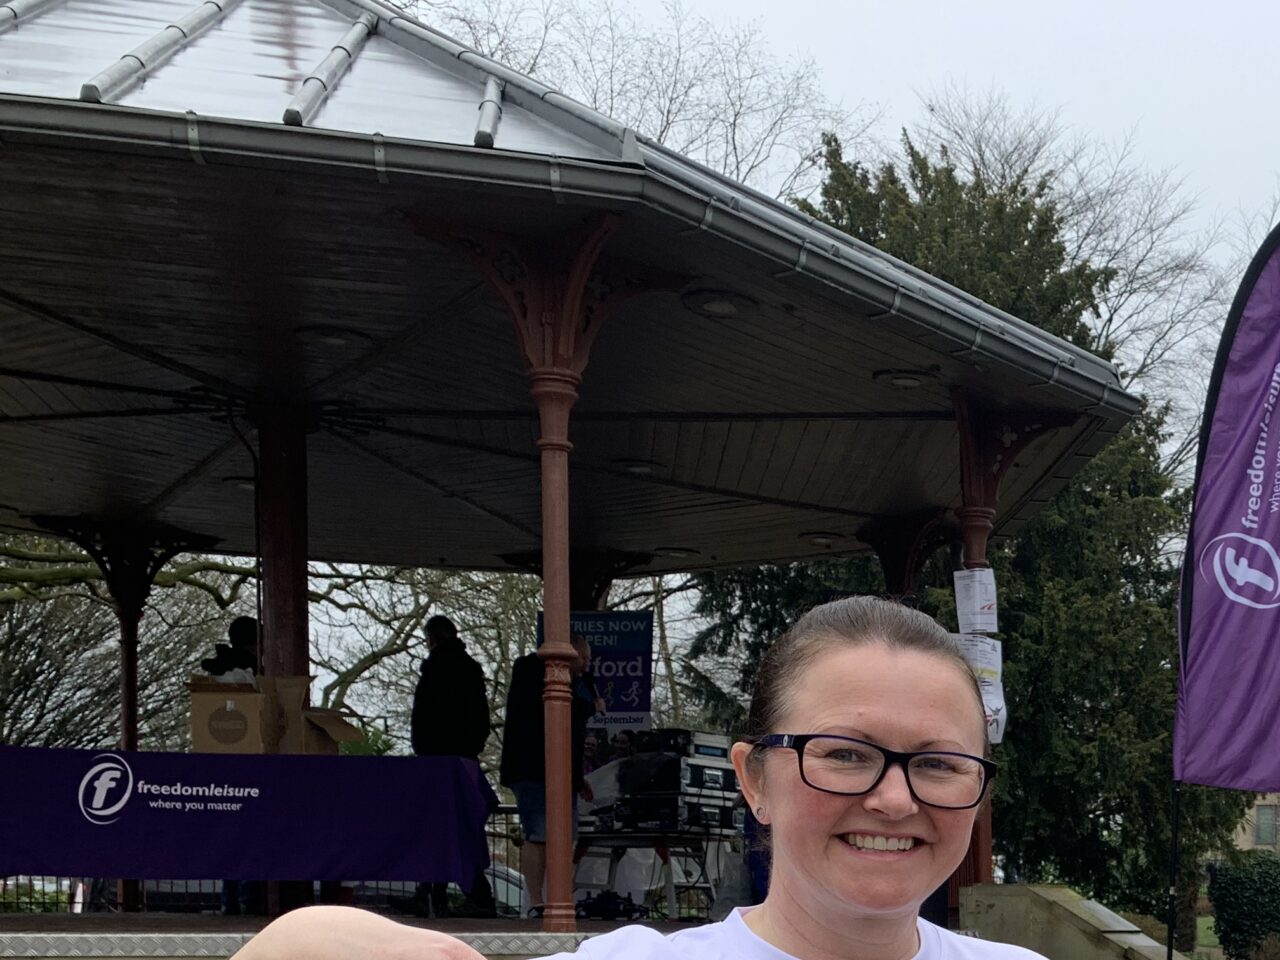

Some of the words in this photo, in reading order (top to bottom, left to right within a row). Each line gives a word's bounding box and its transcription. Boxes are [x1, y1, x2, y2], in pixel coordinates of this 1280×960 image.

[609, 621, 647, 632] NOW
[585, 634, 618, 647] PEN!
[593, 715, 644, 725] September
[137, 780, 260, 797] freedomleisure
[149, 799, 182, 810] where
[185, 802, 204, 812] you
[207, 802, 242, 811] matter
